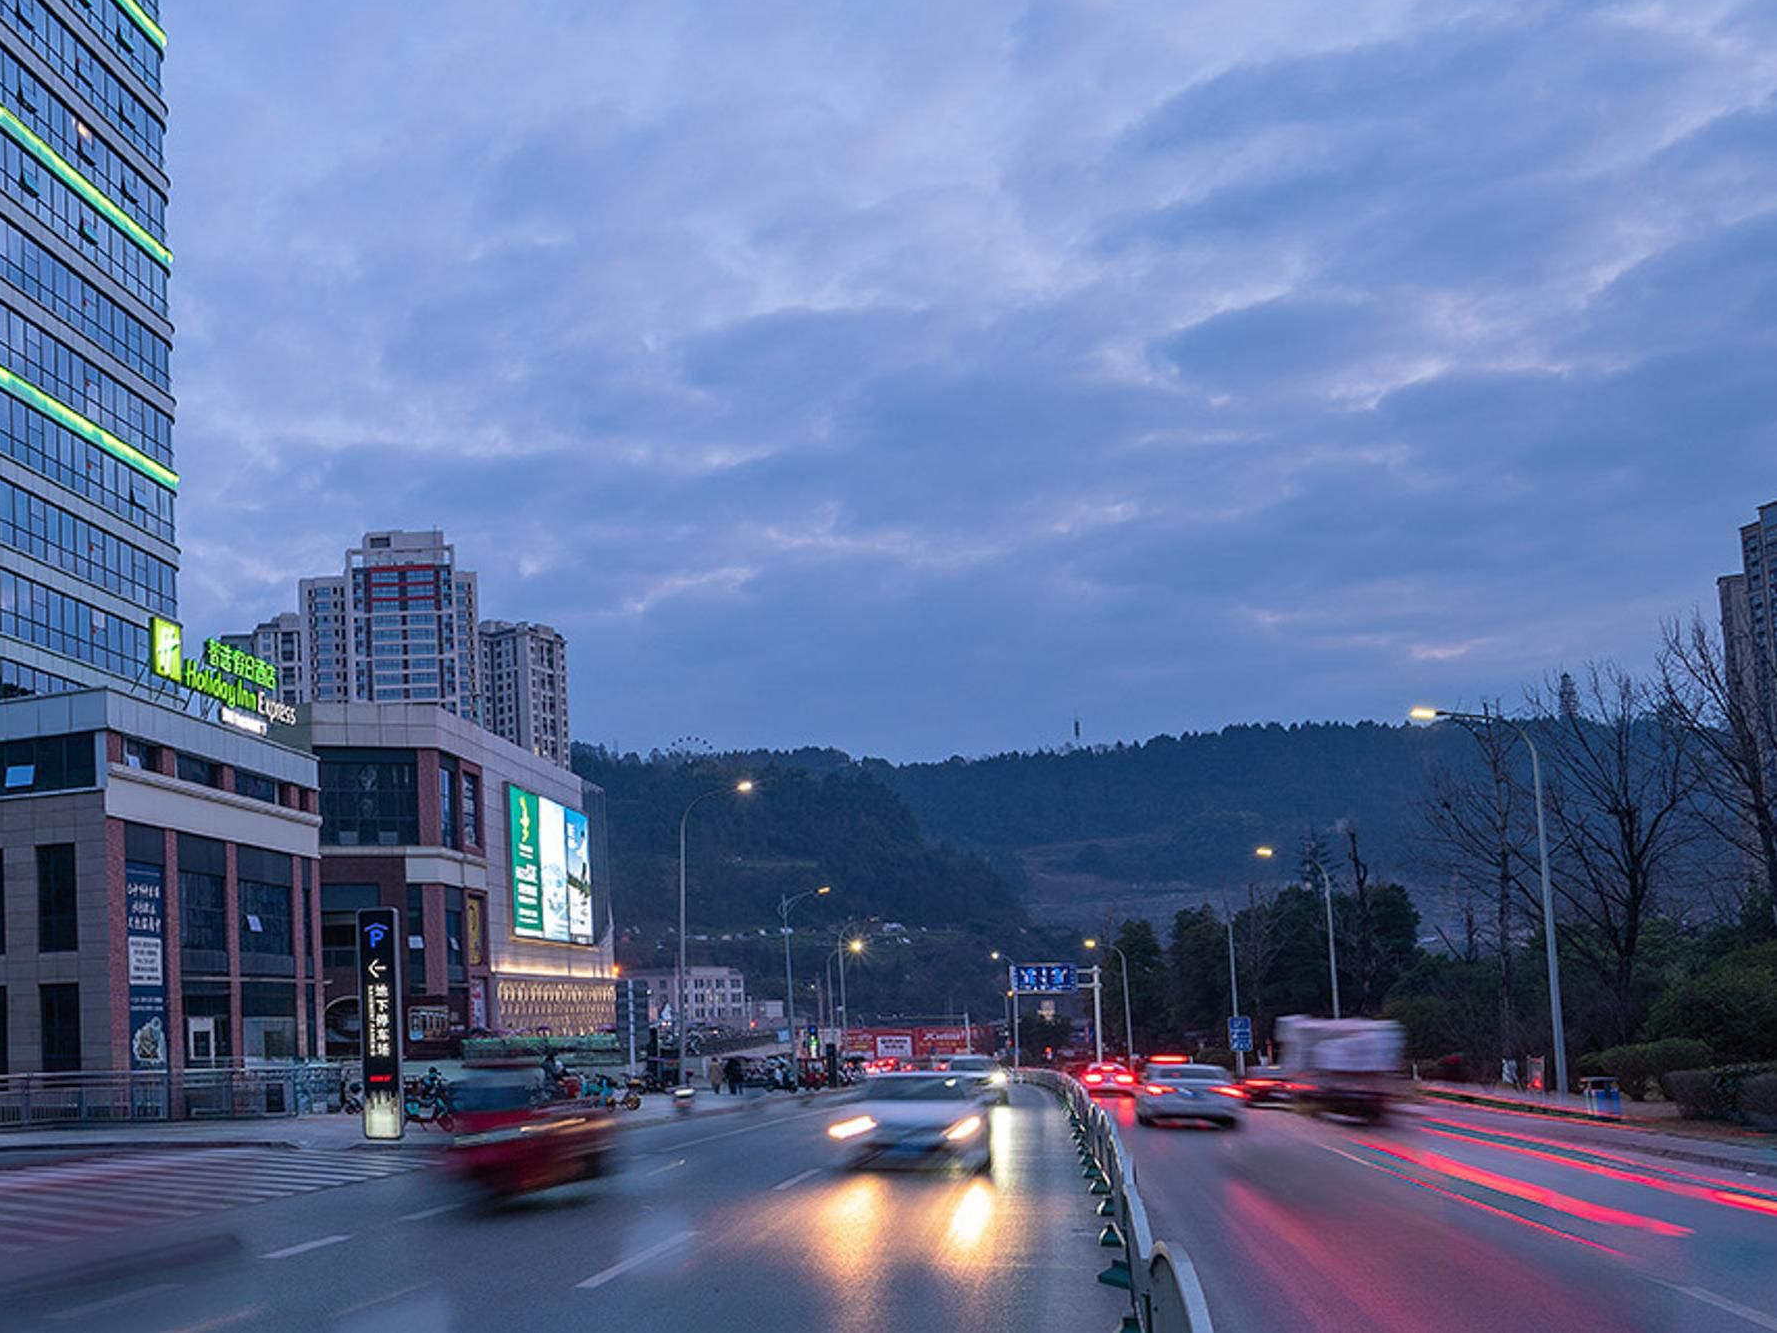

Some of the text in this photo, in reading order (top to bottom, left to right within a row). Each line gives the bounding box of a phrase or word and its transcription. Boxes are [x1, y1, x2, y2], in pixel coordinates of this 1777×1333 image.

[186, 659, 236, 709] Holiday
[237, 678, 257, 711] Inn
[257, 691, 297, 725] Express
[370, 929, 384, 948] P
